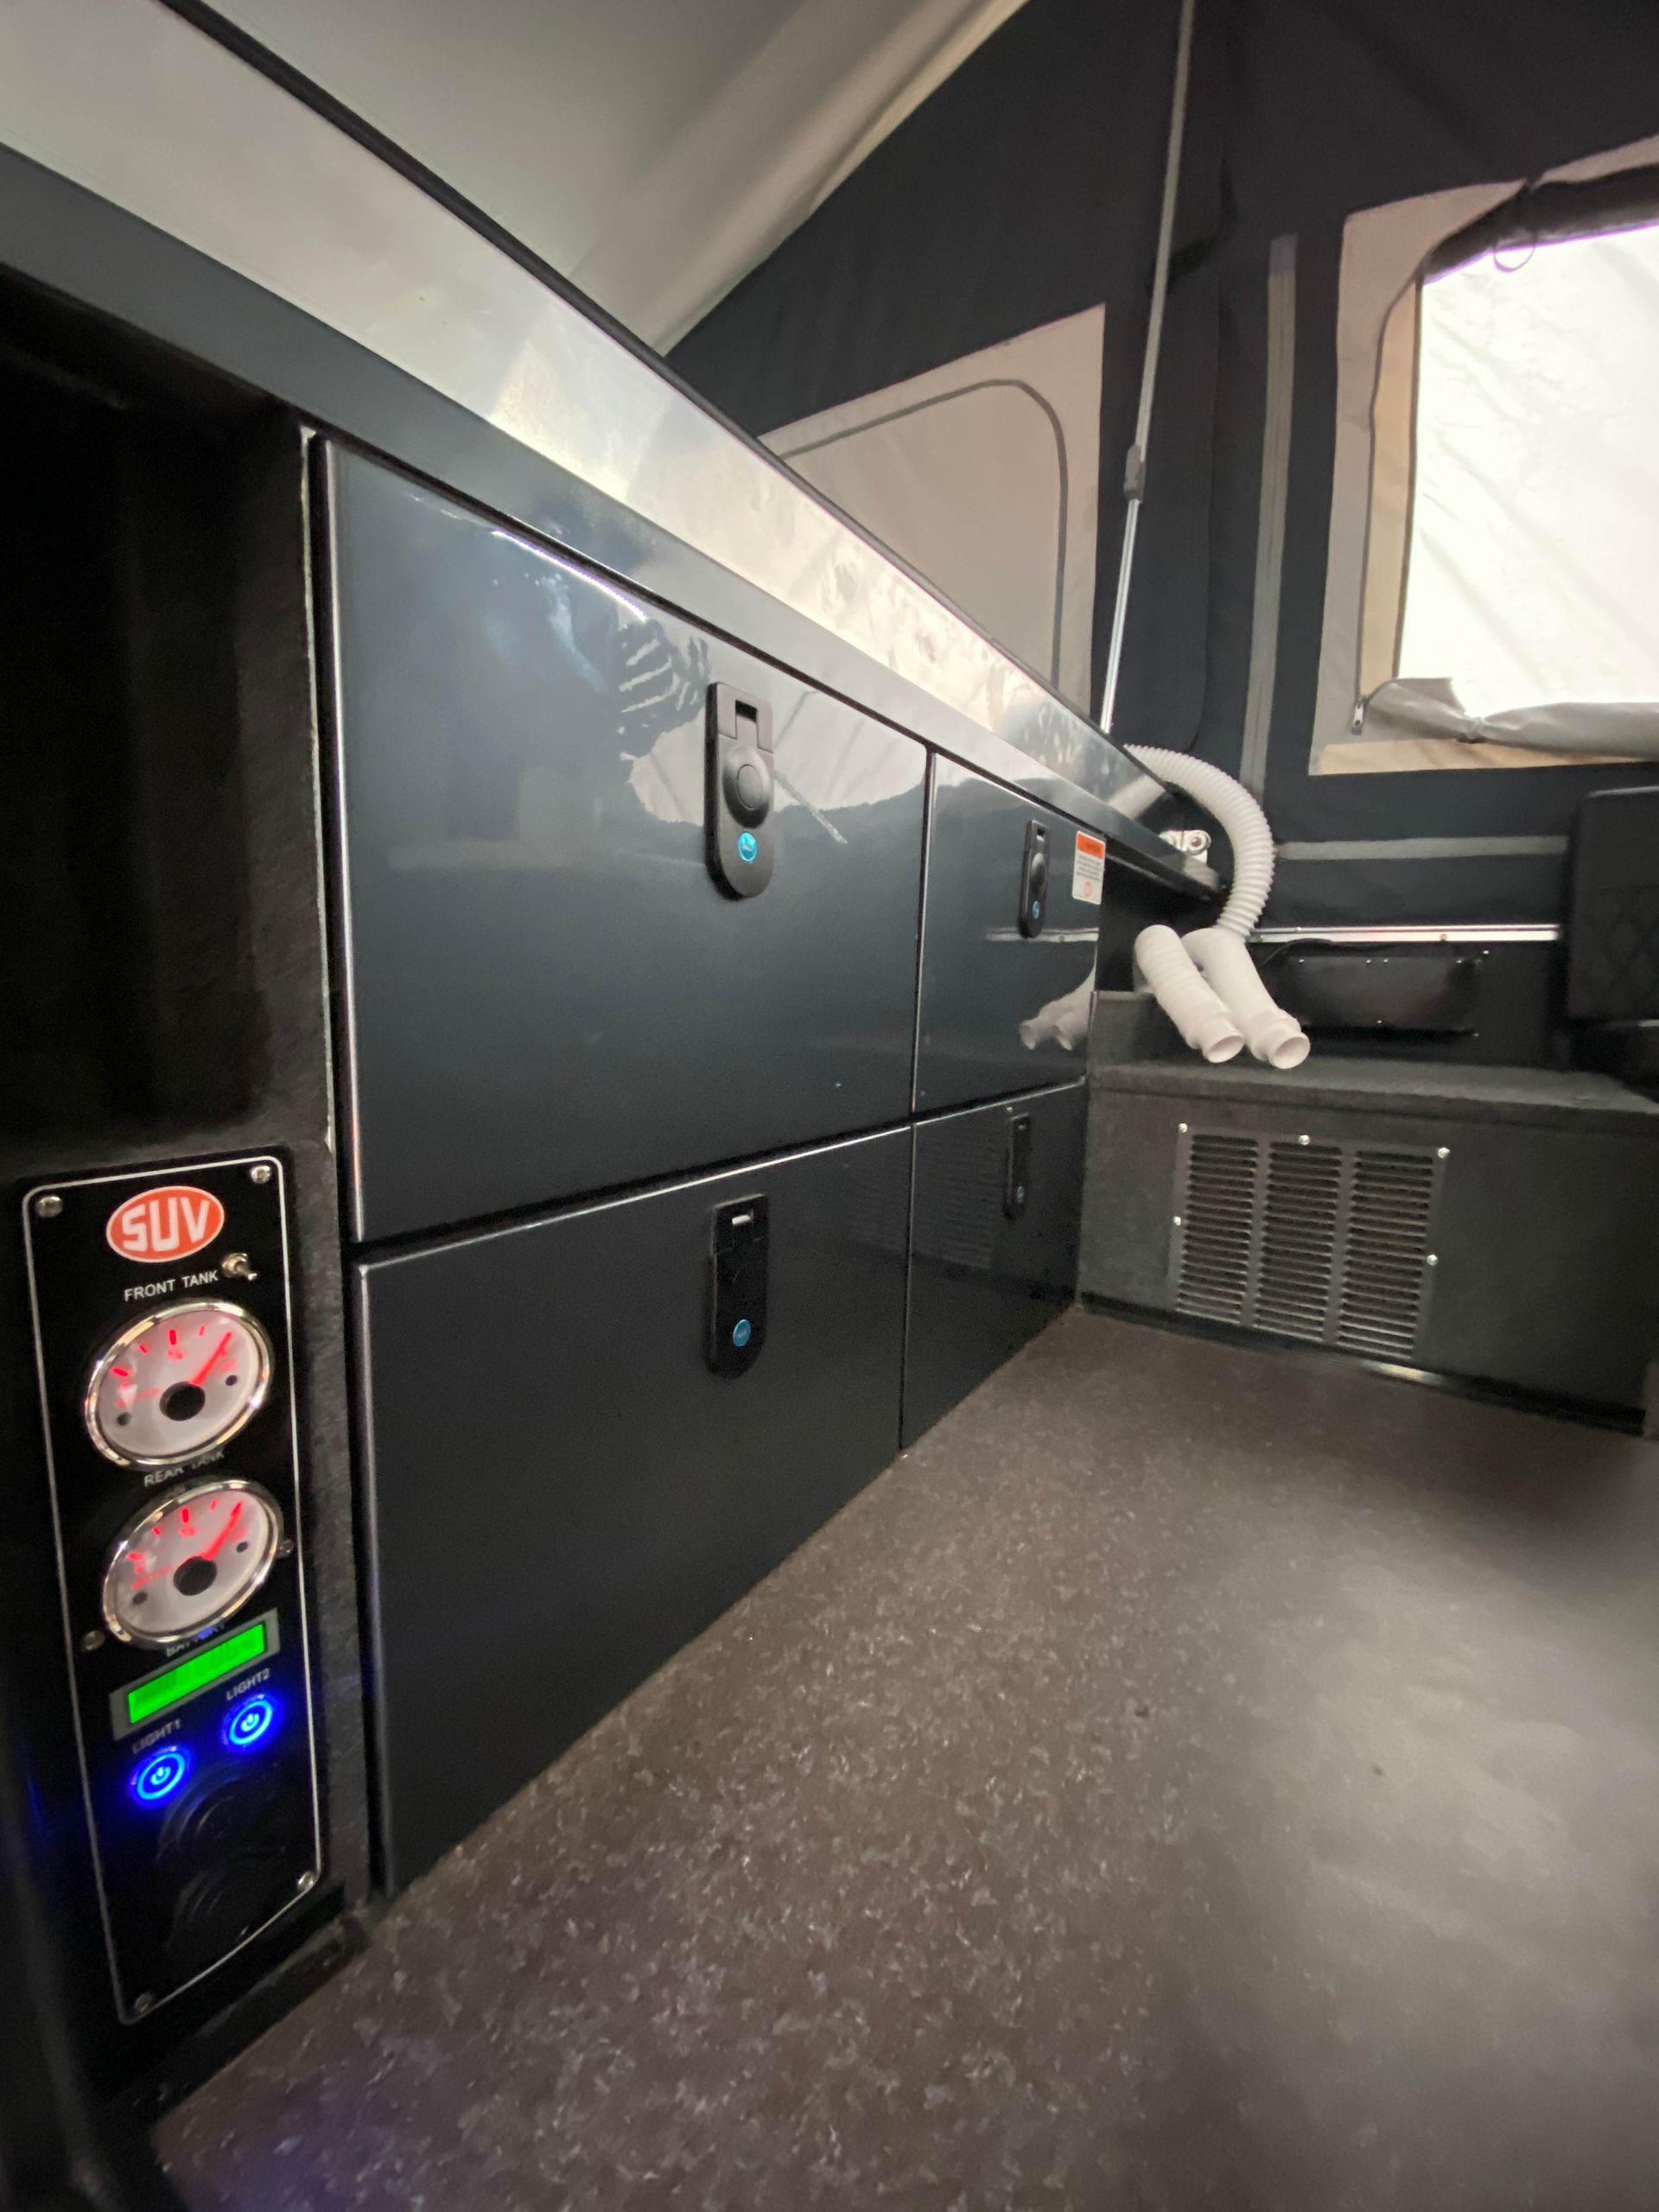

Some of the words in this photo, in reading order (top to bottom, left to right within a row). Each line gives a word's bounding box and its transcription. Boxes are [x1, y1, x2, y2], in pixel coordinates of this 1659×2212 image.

[122, 1197, 209, 1252] SUV
[124, 1279, 175, 1302] FRONT
[181, 1270, 219, 1288] TANK
[143, 1465, 184, 1487] REAR
[226, 1668, 270, 1700] LIGHT2
